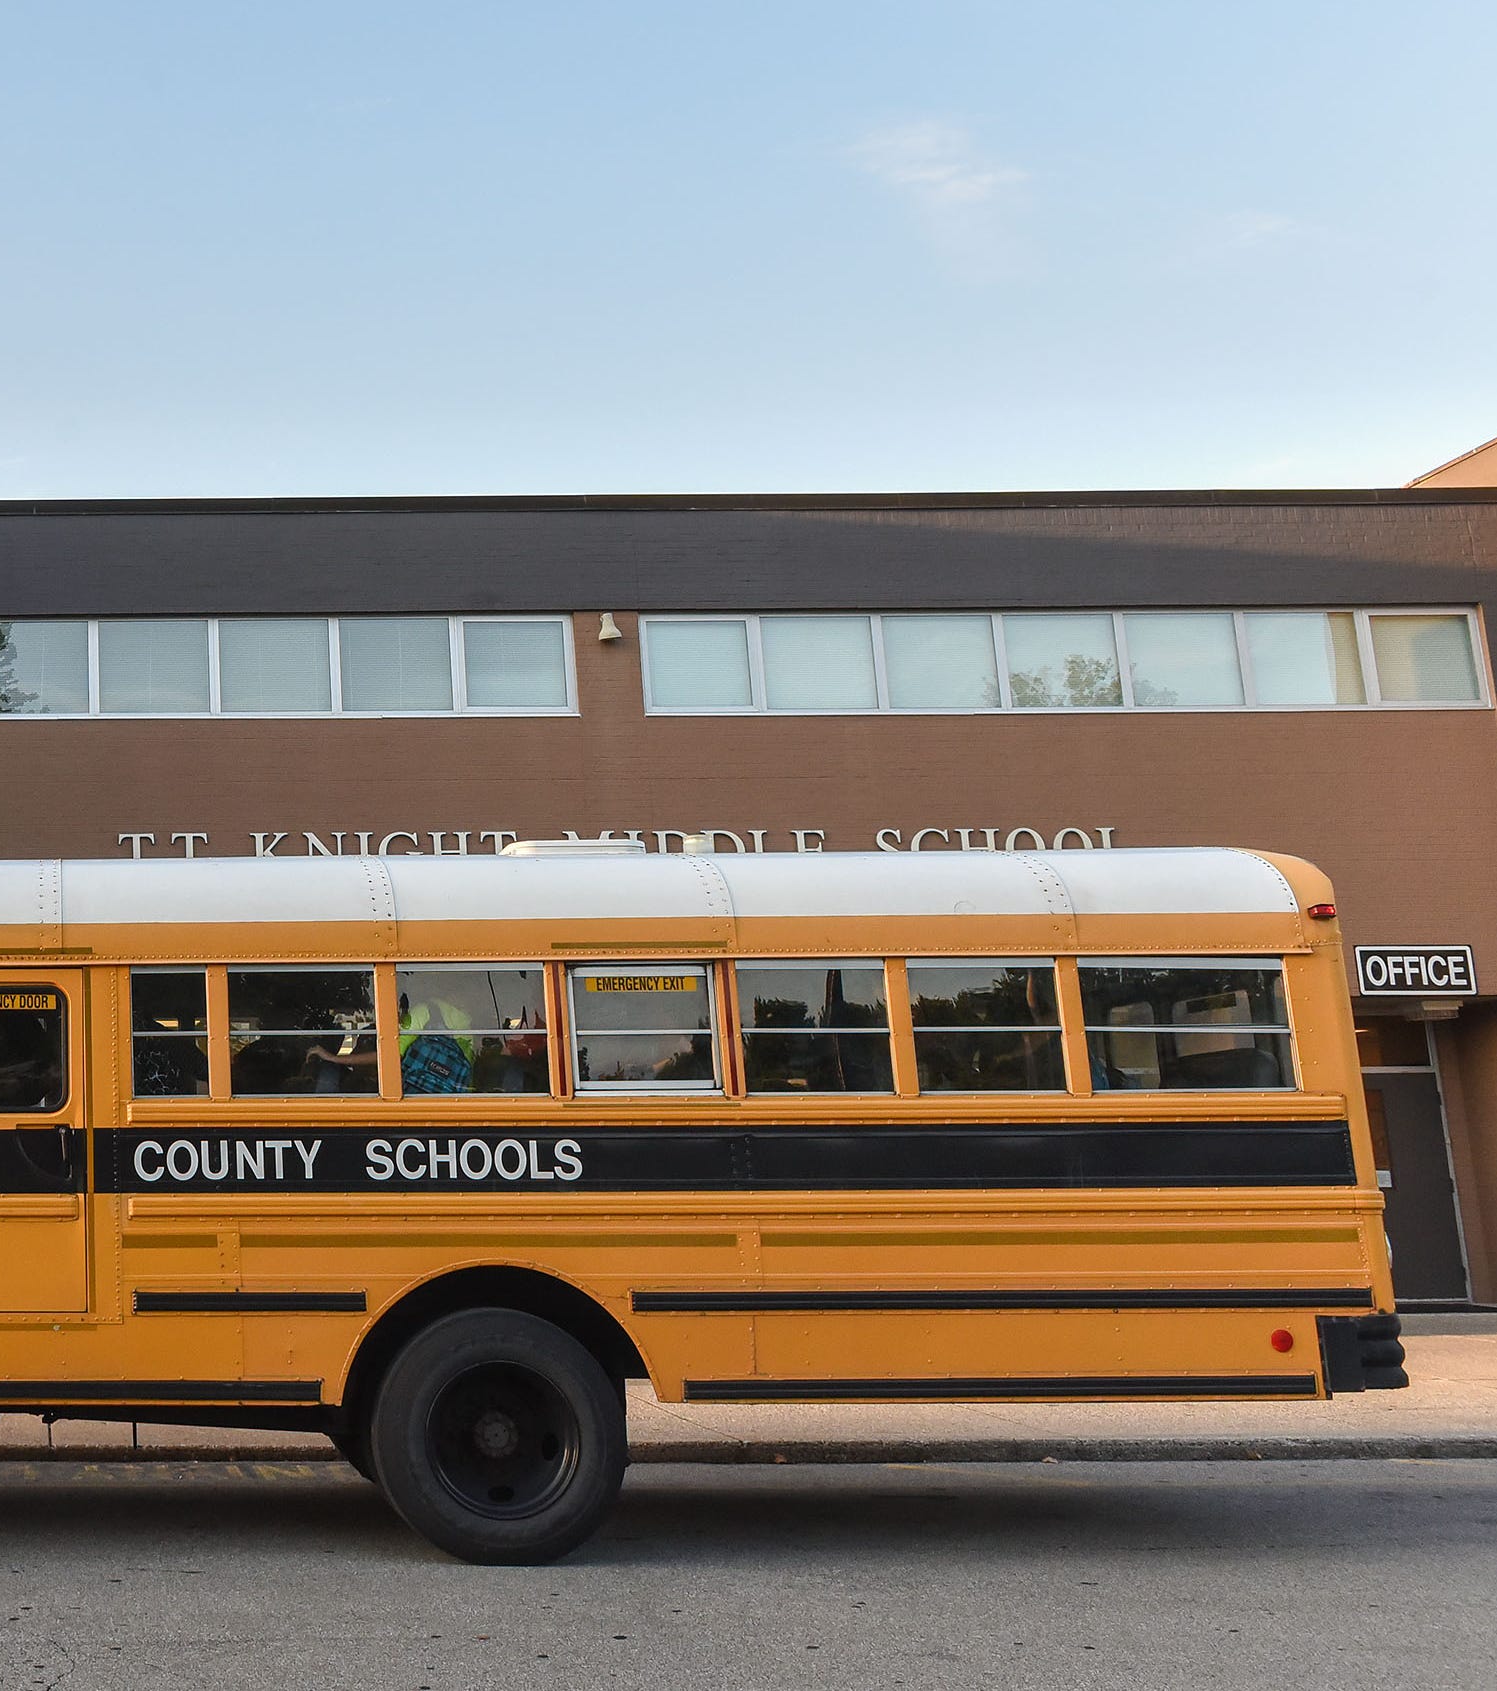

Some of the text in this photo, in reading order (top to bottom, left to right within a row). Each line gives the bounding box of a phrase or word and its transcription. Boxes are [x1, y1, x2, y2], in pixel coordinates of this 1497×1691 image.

[249, 830, 518, 858] KNIGHT
[561, 829, 825, 854] DDLE
[874, 826, 1116, 852] SCHOOL
[595, 976, 686, 991] EMERGENCY EXIT
[1365, 955, 1468, 987] OFFICE
[19, 995, 49, 1008] DOOR
[133, 1139, 323, 1182] COUNTY
[365, 1138, 583, 1182] SCHOOLS
